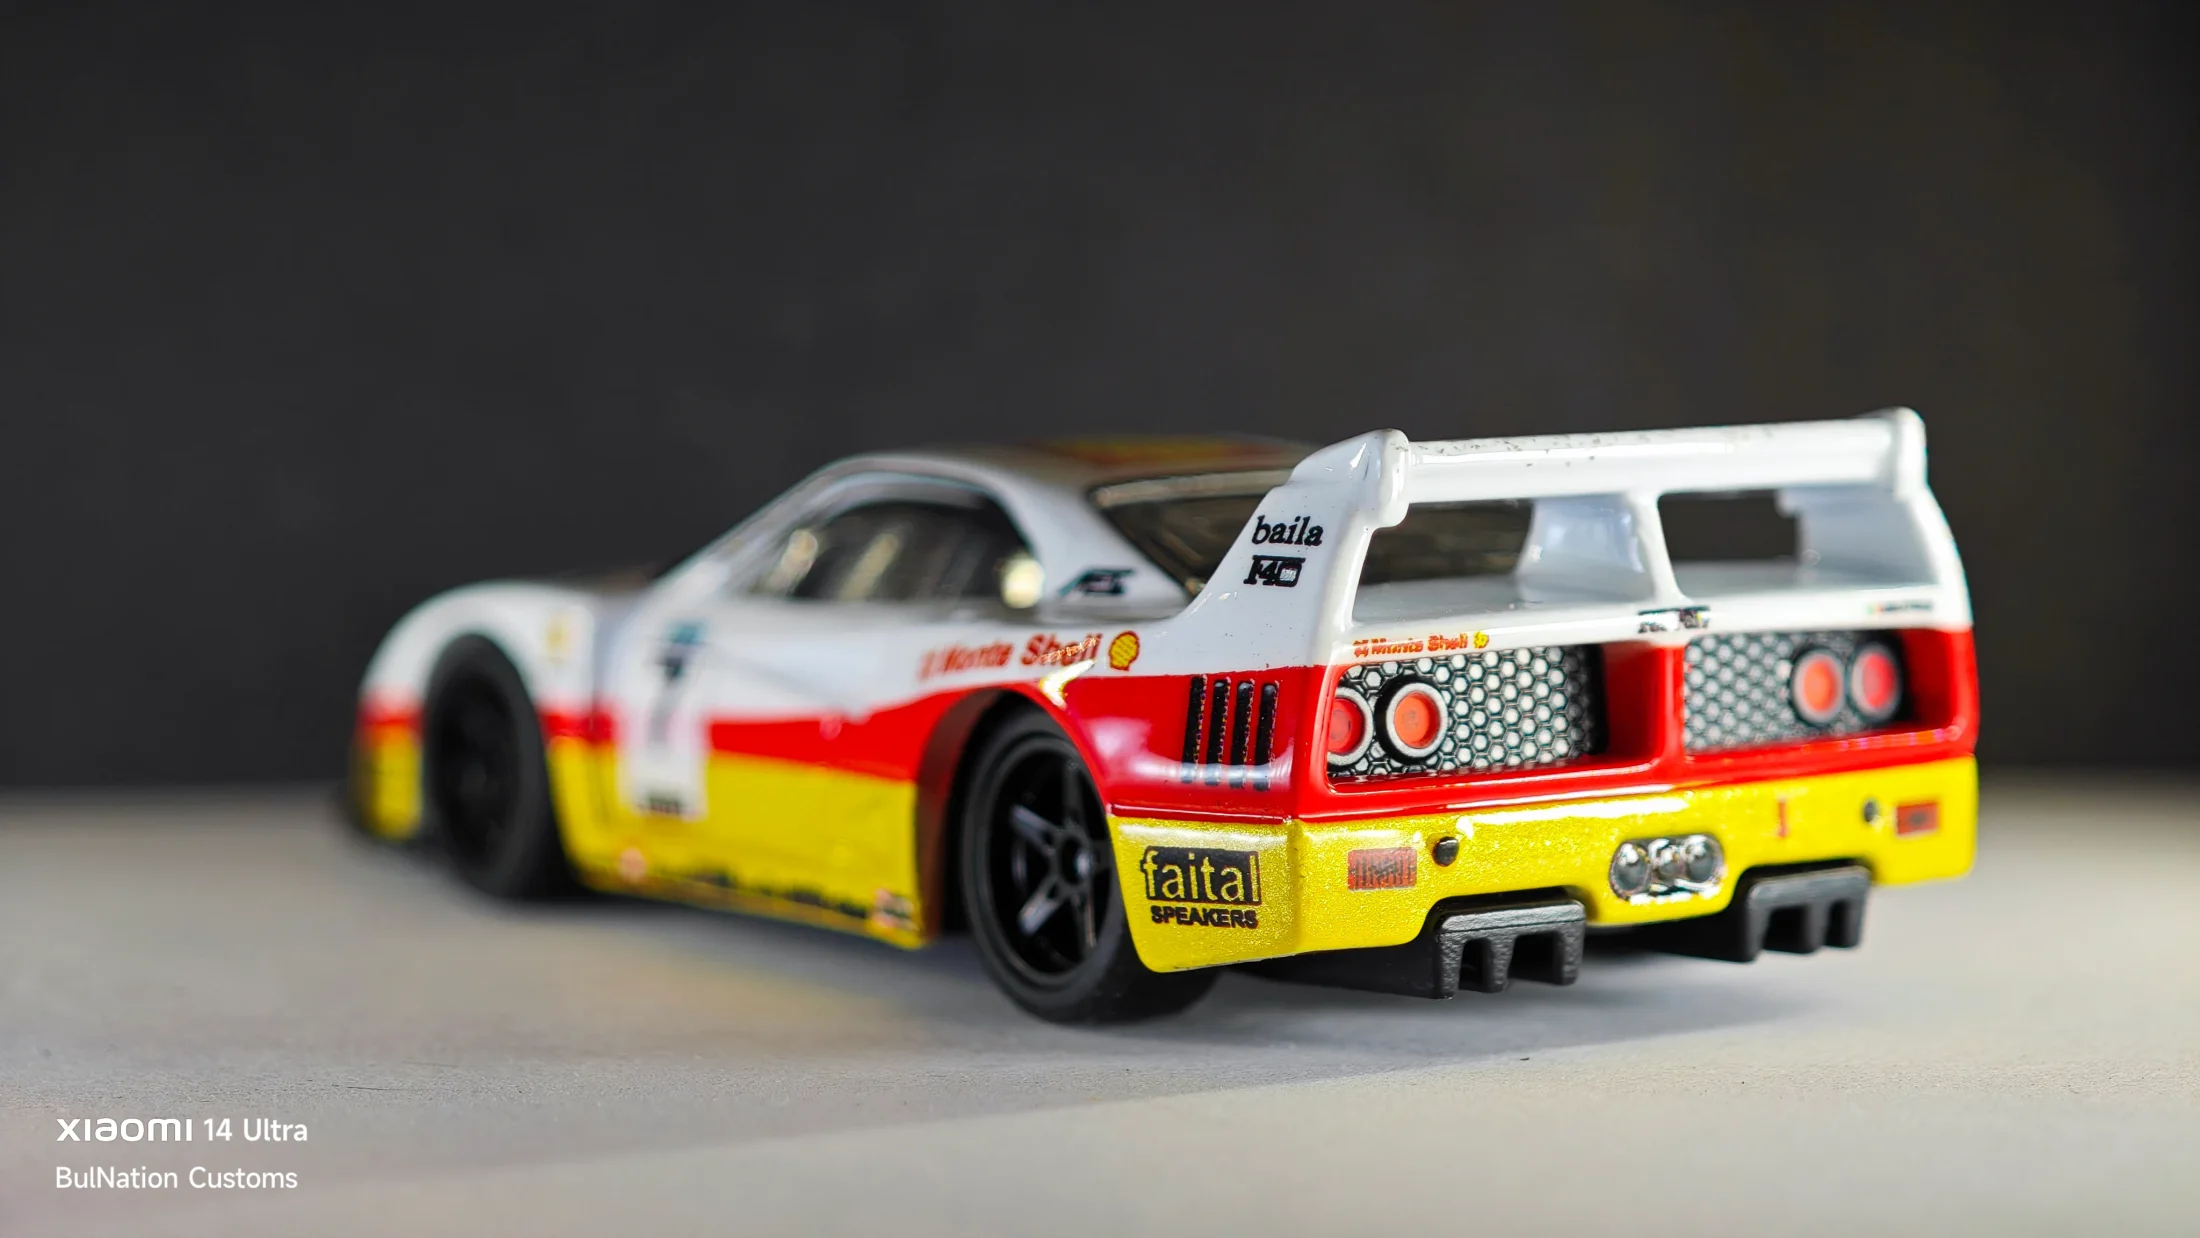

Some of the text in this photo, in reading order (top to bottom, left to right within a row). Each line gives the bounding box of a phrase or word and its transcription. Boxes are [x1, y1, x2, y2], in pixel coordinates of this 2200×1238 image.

[1251, 514, 1324, 547] baila
[1142, 849, 1261, 903] faital
[1150, 904, 1259, 930] SPEAKERS
